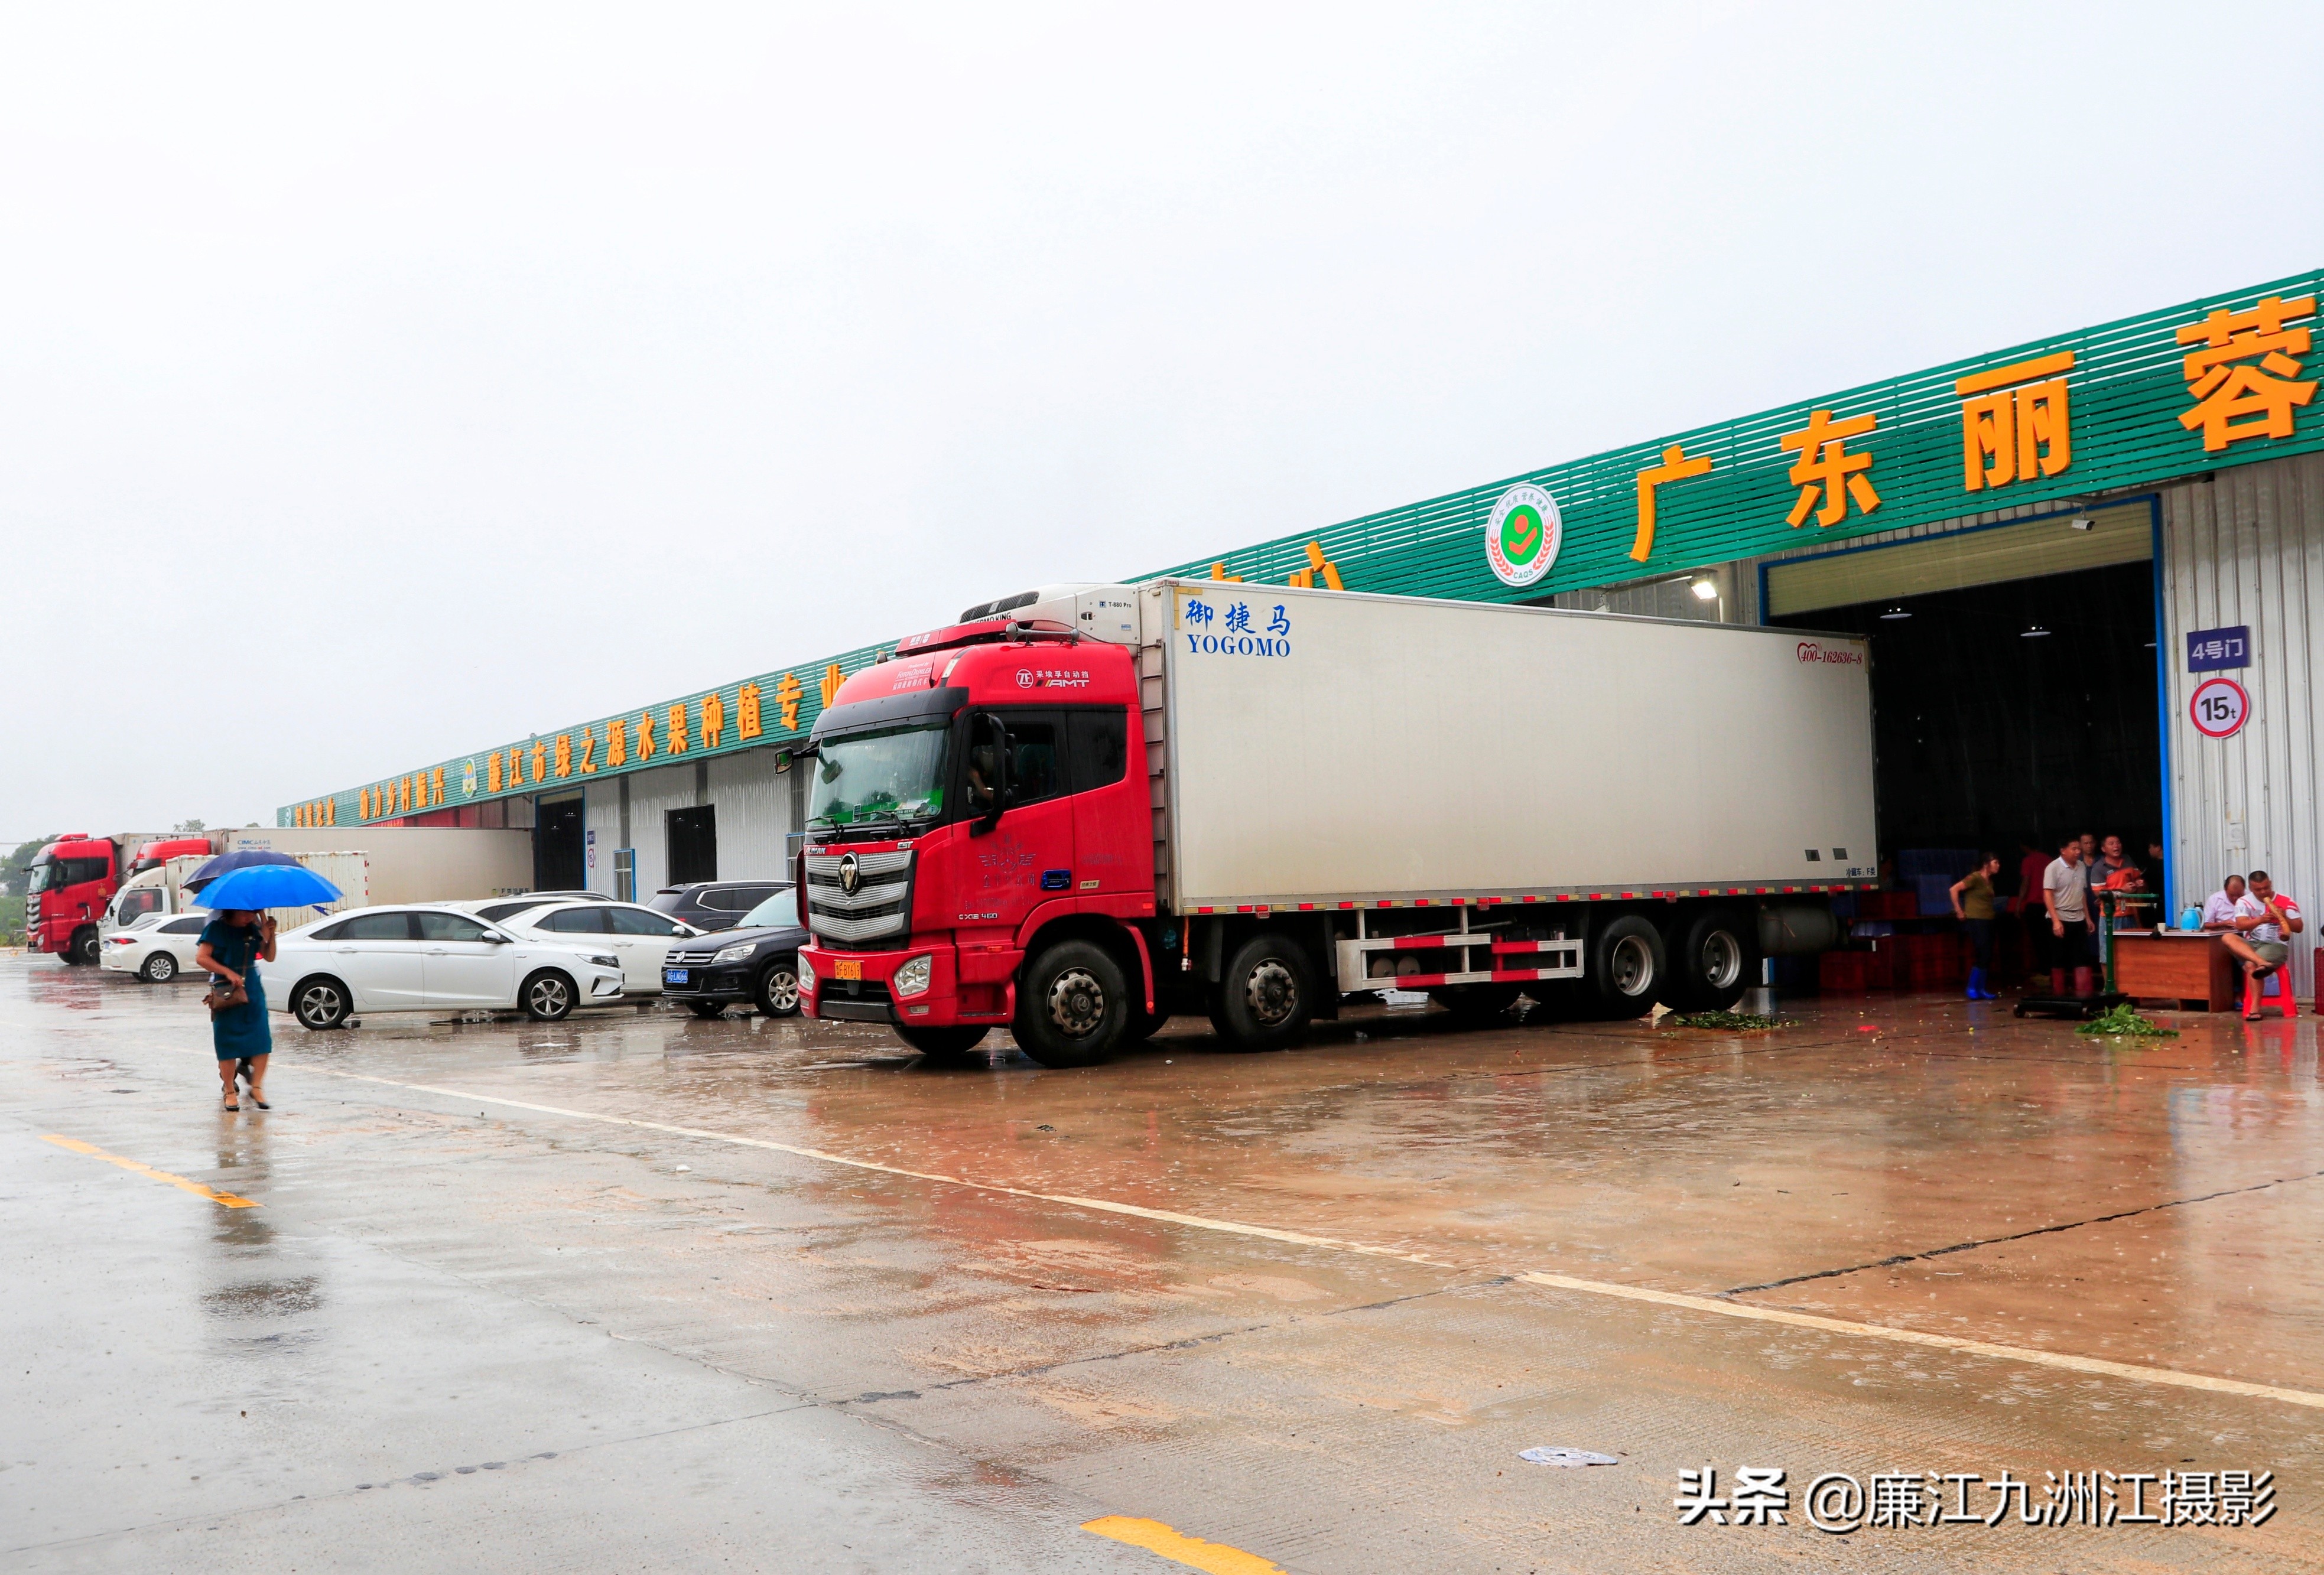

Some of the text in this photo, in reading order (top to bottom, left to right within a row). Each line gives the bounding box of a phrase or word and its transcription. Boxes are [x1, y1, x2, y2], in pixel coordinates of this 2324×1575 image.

[1630, 295, 2319, 563] 广东丽蓉
[1513, 569, 1533, 579] CAQS
[1185, 599, 1291, 635] 御捷马
[1187, 634, 1291, 658] YOGOMO
[1801, 650, 1863, 665] 400-162636-8
[2192, 638, 2244, 660] 4号门
[1016, 669, 1033, 688] ZF
[488, 651, 886, 793] 廉江市绿之源水果种植专业
[360, 766, 444, 820] 助力乡村振兴
